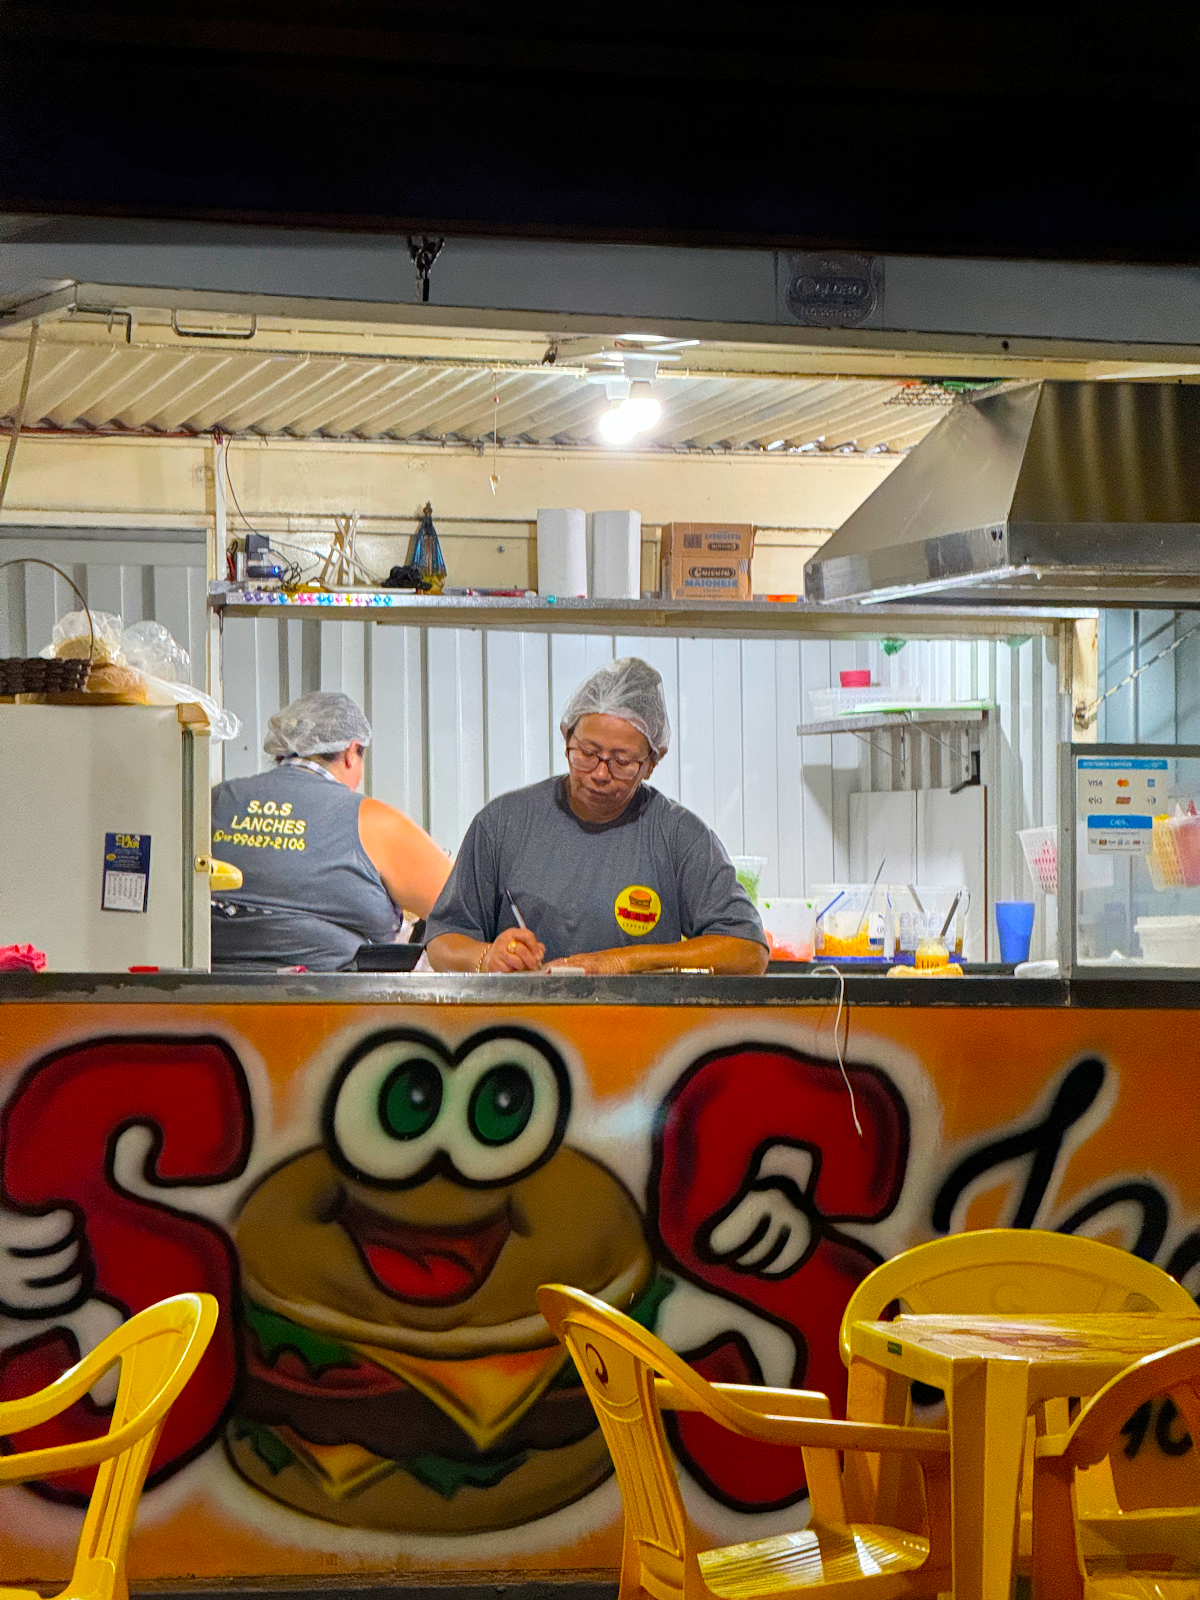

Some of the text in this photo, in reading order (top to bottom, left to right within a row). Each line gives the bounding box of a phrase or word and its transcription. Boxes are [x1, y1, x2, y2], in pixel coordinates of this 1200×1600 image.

[685, 579, 738, 587] MAIONESE
[247, 800, 293, 816] S.O.S
[231, 815, 306, 835] LANCHES
